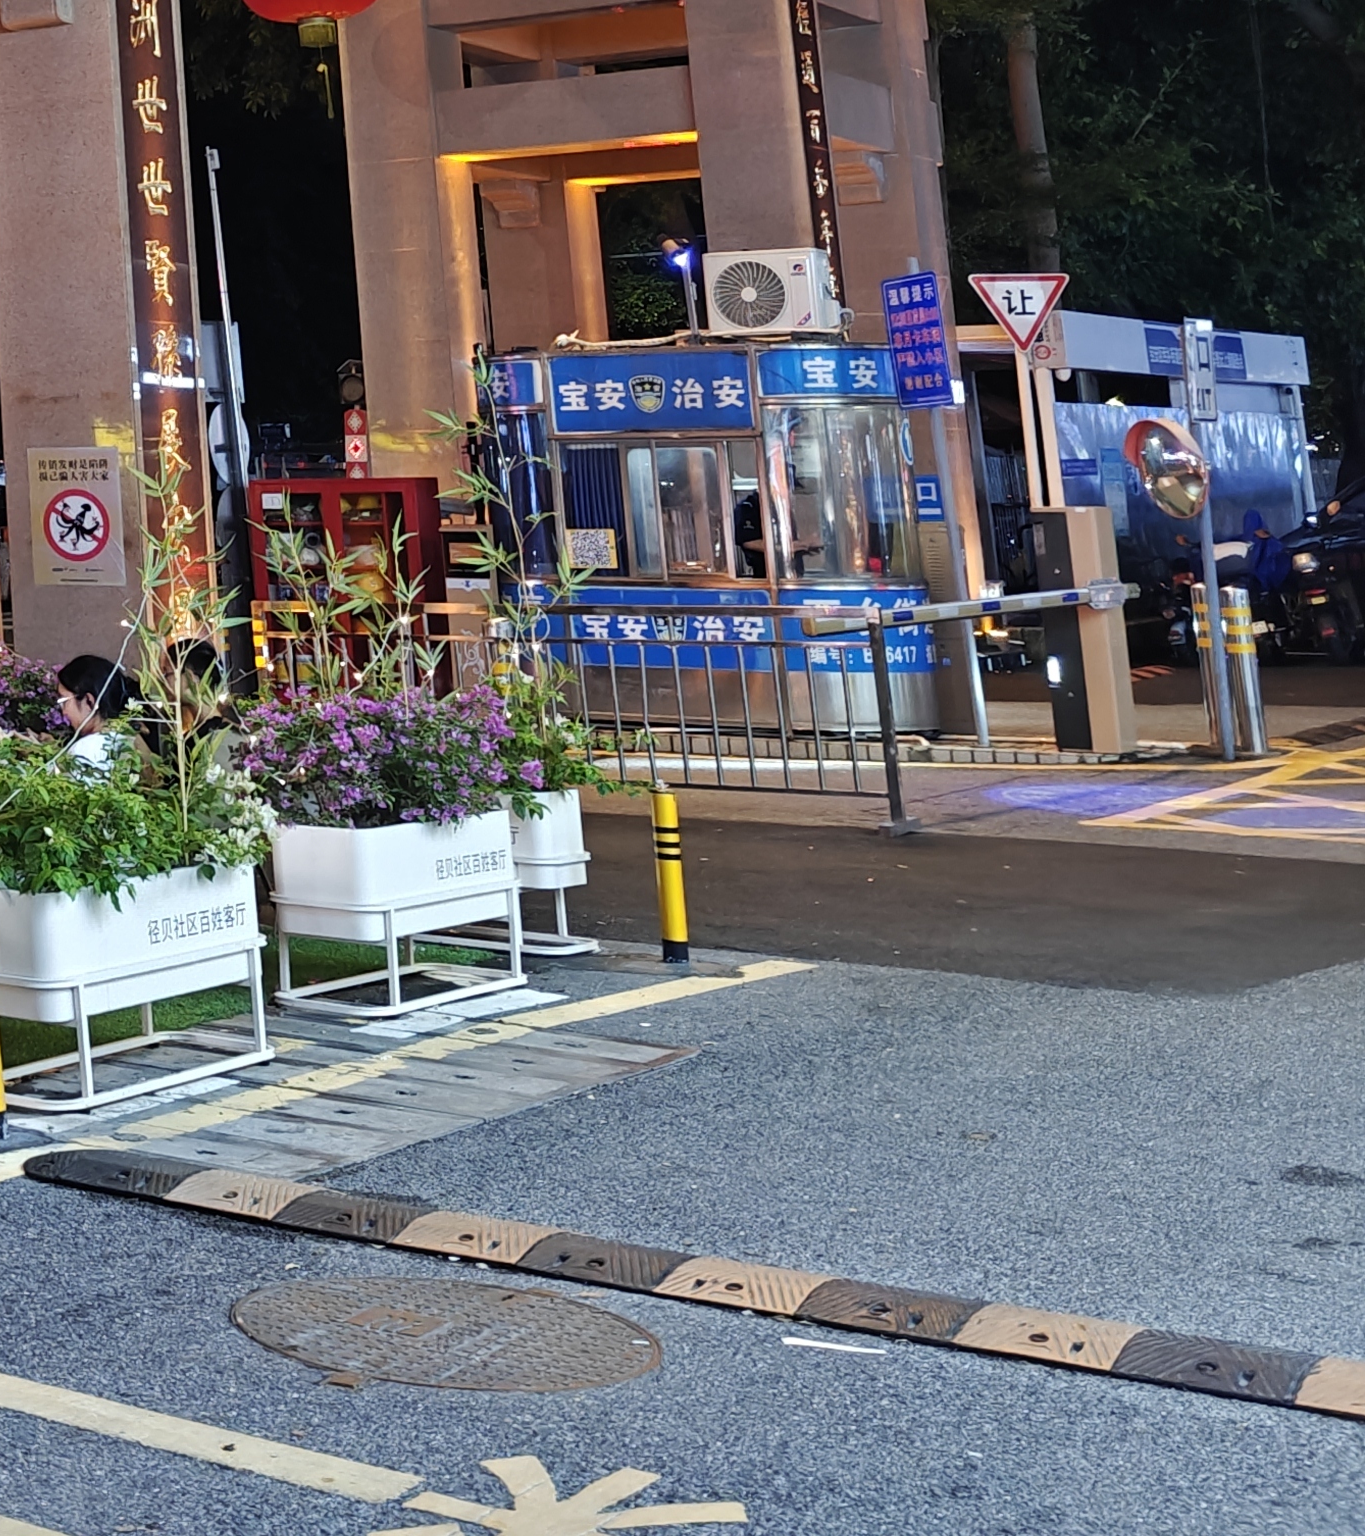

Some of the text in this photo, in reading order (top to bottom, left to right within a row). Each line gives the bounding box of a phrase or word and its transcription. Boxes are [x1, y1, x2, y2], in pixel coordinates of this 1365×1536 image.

[1002, 289, 1036, 315] 让
[802, 356, 878, 390] 宝安
[558, 375, 745, 411] 宝安 治安
[38, 458, 109, 472] 传销发财是陷阱
[581, 615, 766, 642] 宝安 治安
[435, 848, 507, 881] 径贝社区百姓客厅
[147, 902, 246, 945] 径贝社区百姓客厅
